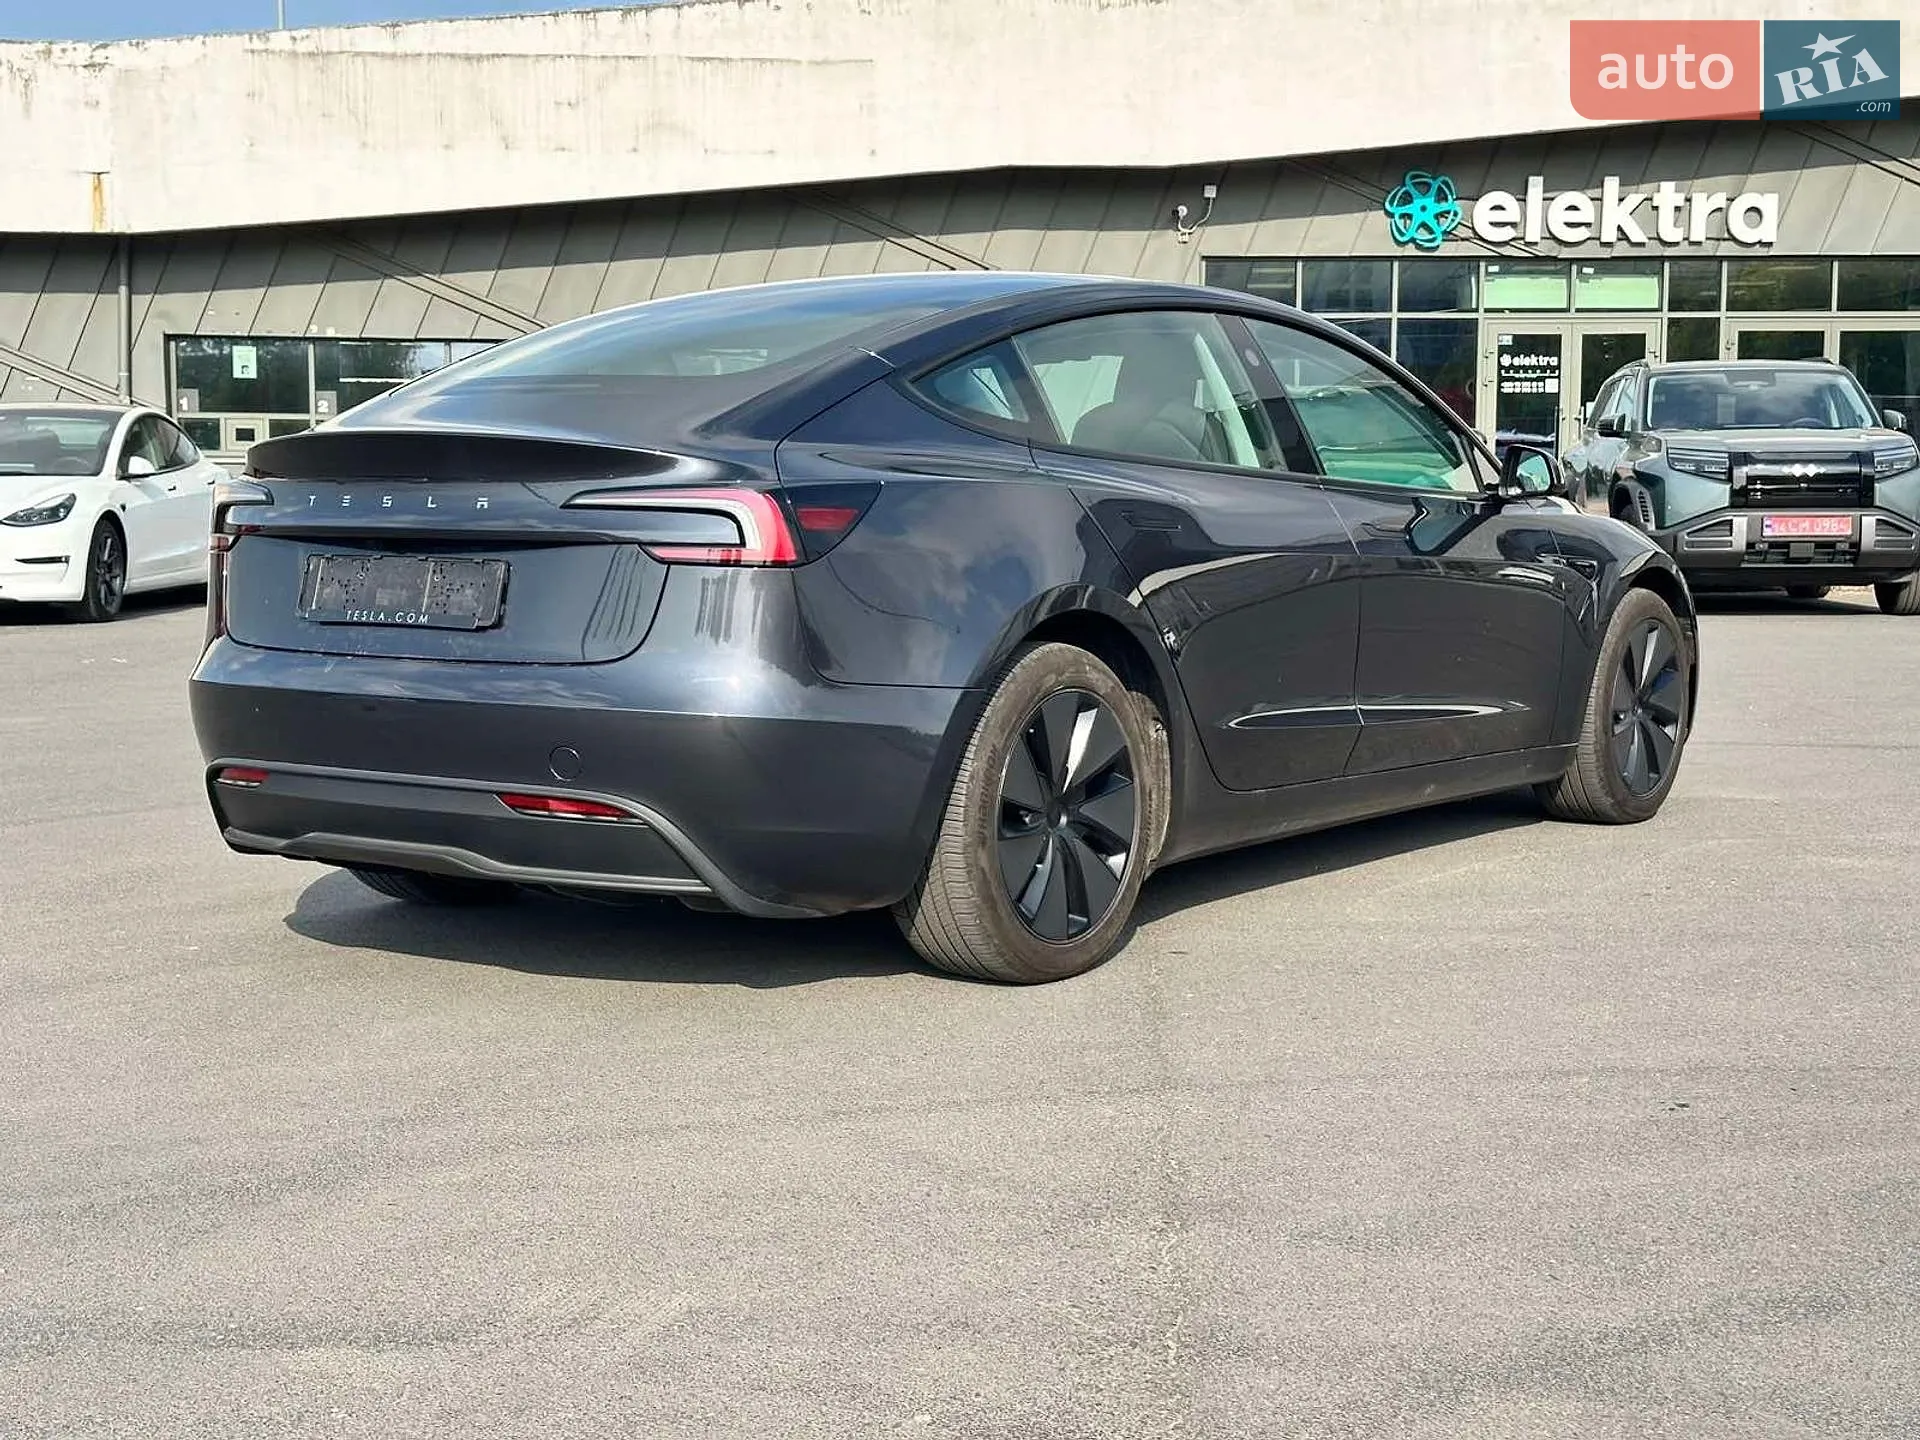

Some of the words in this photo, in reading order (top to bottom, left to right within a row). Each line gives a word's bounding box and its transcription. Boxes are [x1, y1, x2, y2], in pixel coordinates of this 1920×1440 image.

[1472, 176, 1779, 248] elektra
[1512, 353, 1558, 366] elektra
[317, 399, 329, 413] 2
[308, 495, 489, 509] TESLA
[346, 610, 431, 625] TESLA.COM
